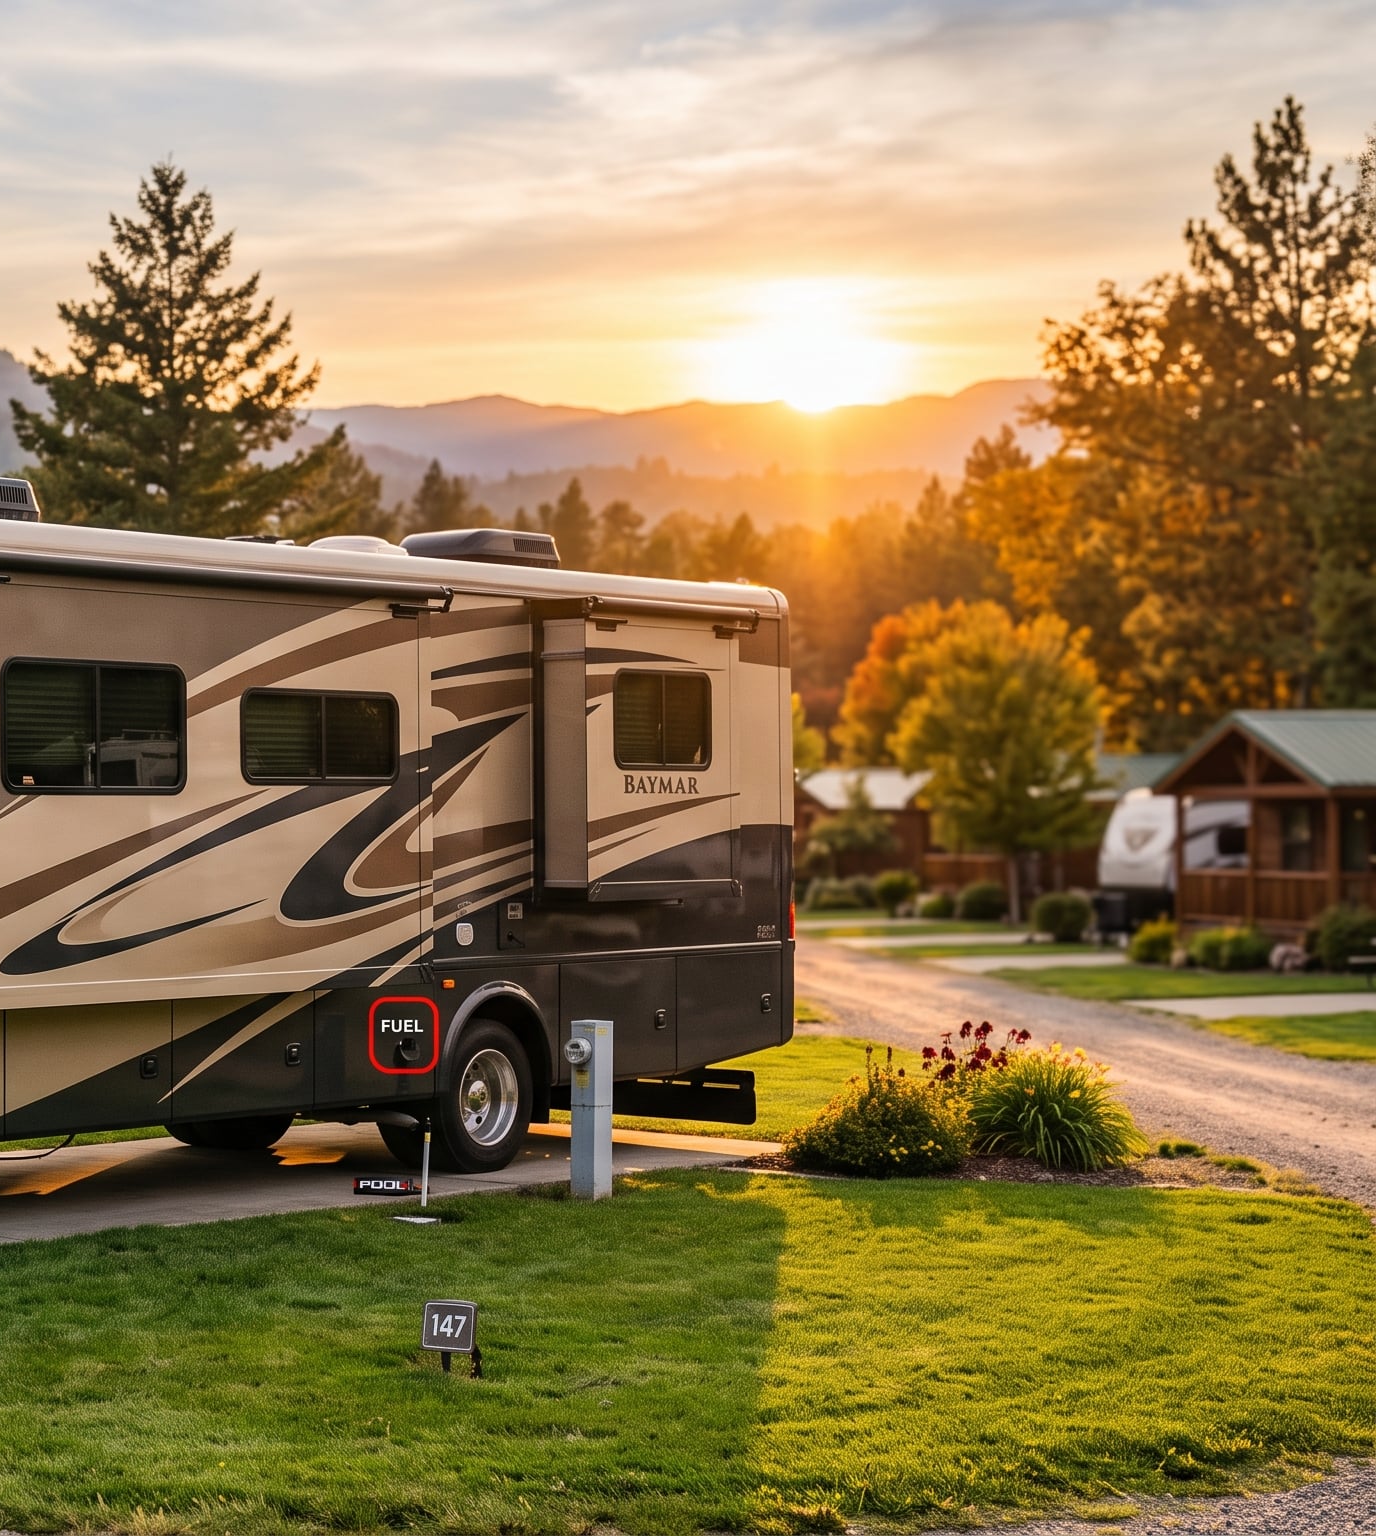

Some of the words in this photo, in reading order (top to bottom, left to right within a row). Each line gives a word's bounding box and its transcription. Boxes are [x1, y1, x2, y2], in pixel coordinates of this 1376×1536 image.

[623, 774, 700, 795] BAYMAR
[359, 1180, 406, 1190] POOL
[431, 1313, 467, 1338] 147
